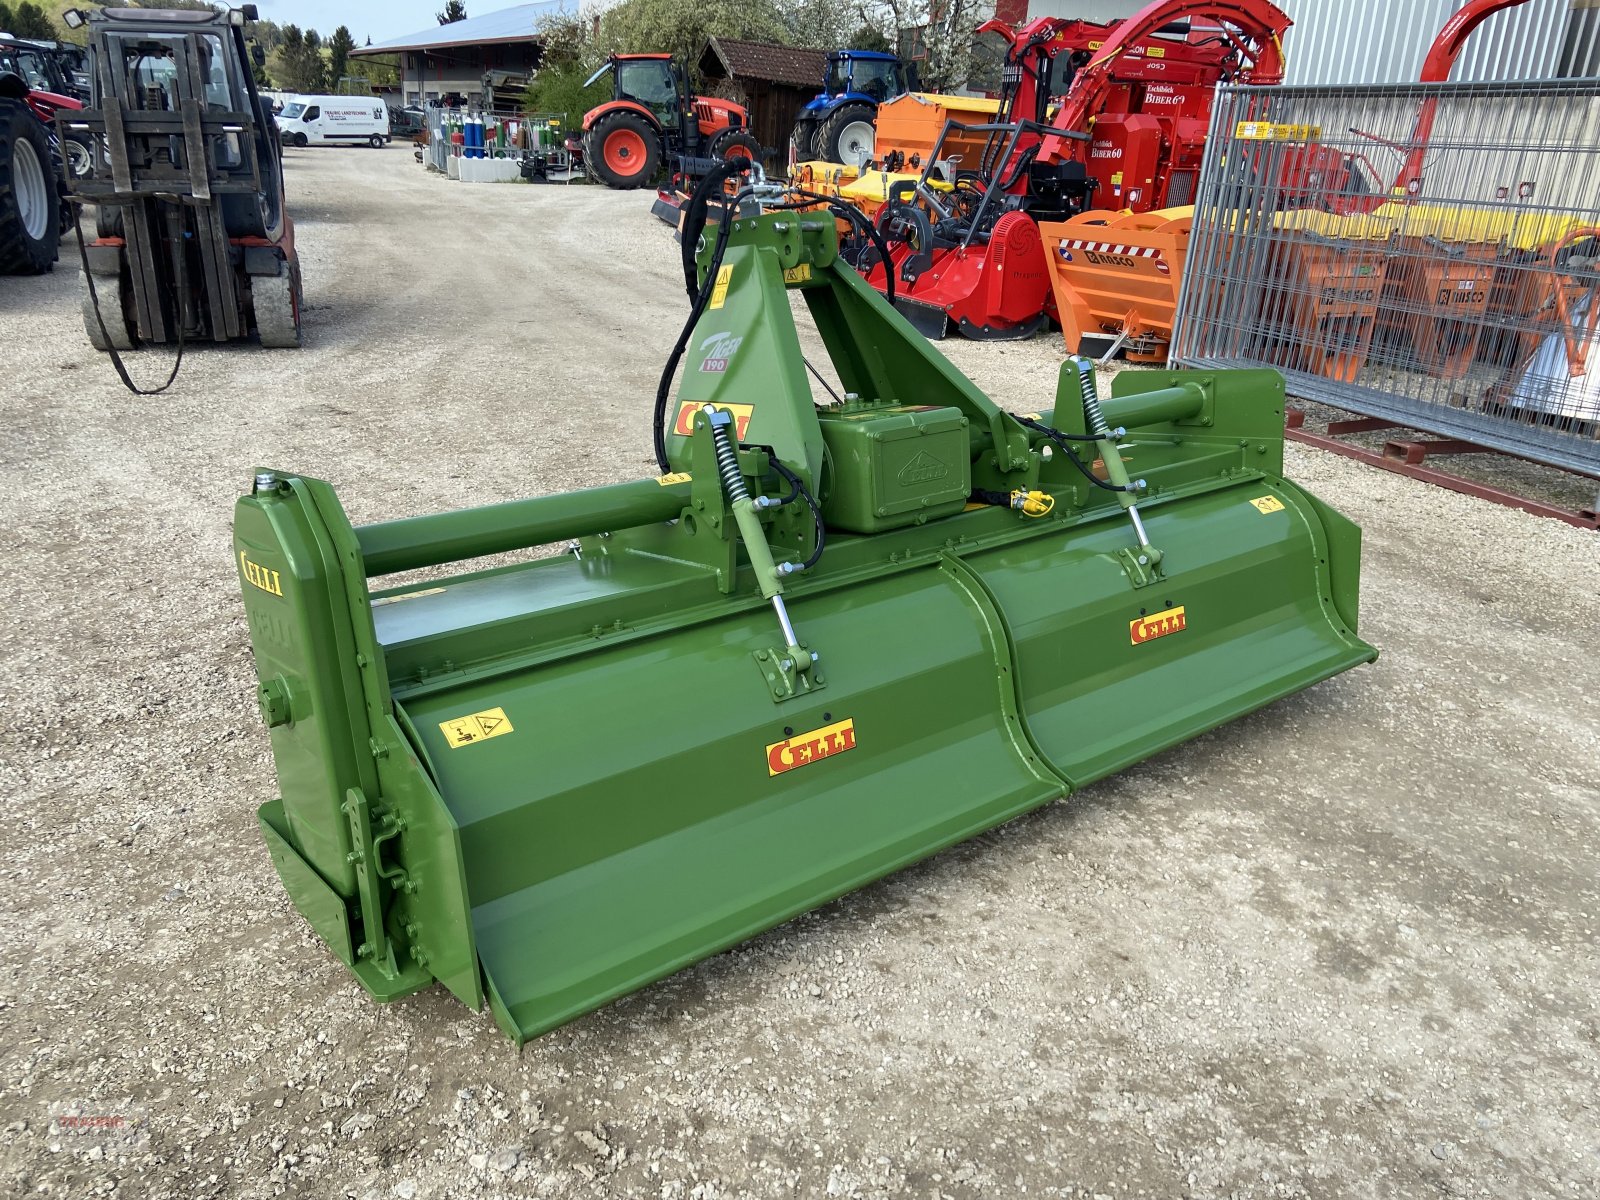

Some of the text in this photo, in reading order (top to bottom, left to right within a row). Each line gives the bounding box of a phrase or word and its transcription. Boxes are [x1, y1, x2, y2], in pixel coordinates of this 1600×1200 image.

[1111, 148, 1122, 158] 60
[1098, 254, 1135, 267] RASCO
[706, 359, 725, 371] 190
[240, 549, 283, 597] CELLI
[1131, 612, 1185, 643] CELLI
[768, 727, 856, 773] CELLI
